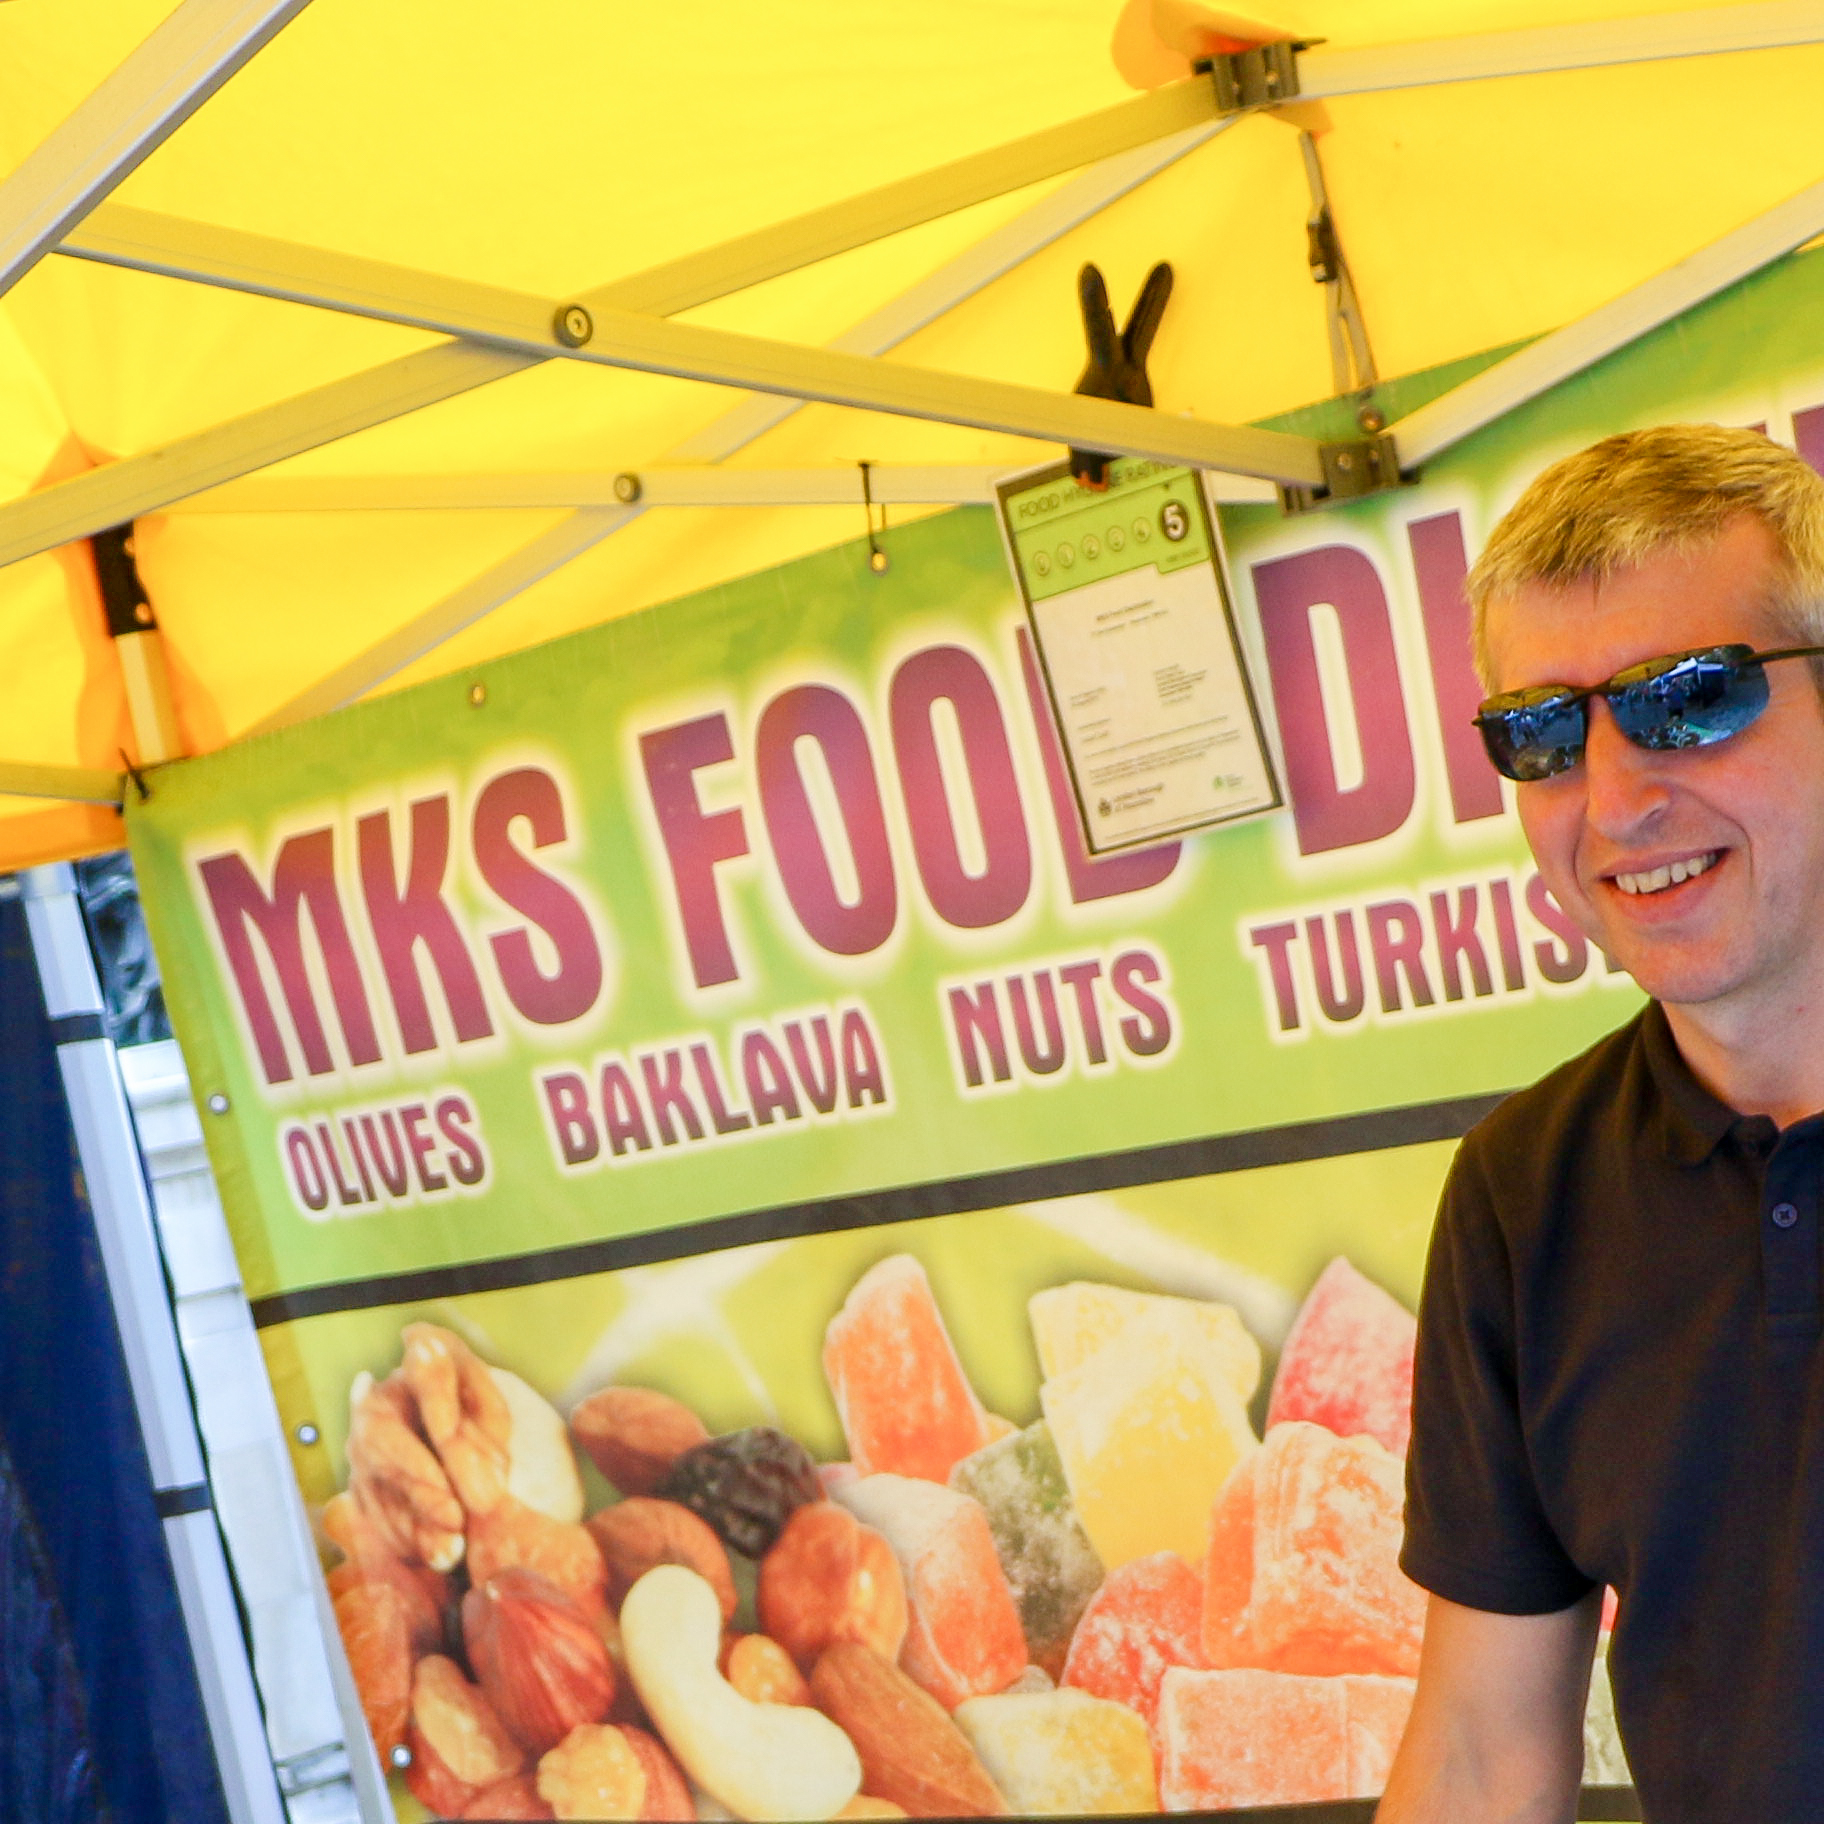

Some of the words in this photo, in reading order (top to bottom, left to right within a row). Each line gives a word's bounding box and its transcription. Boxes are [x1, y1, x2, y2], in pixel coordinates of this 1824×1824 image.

[1162, 503, 1186, 543] 5
[199, 767, 603, 1084] MKS
[286, 1096, 485, 1211] OLIVES
[544, 1008, 887, 1165] BAKLAVA
[950, 950, 1172, 1088] NUTS
[1250, 872, 1625, 1031] TURKIS
